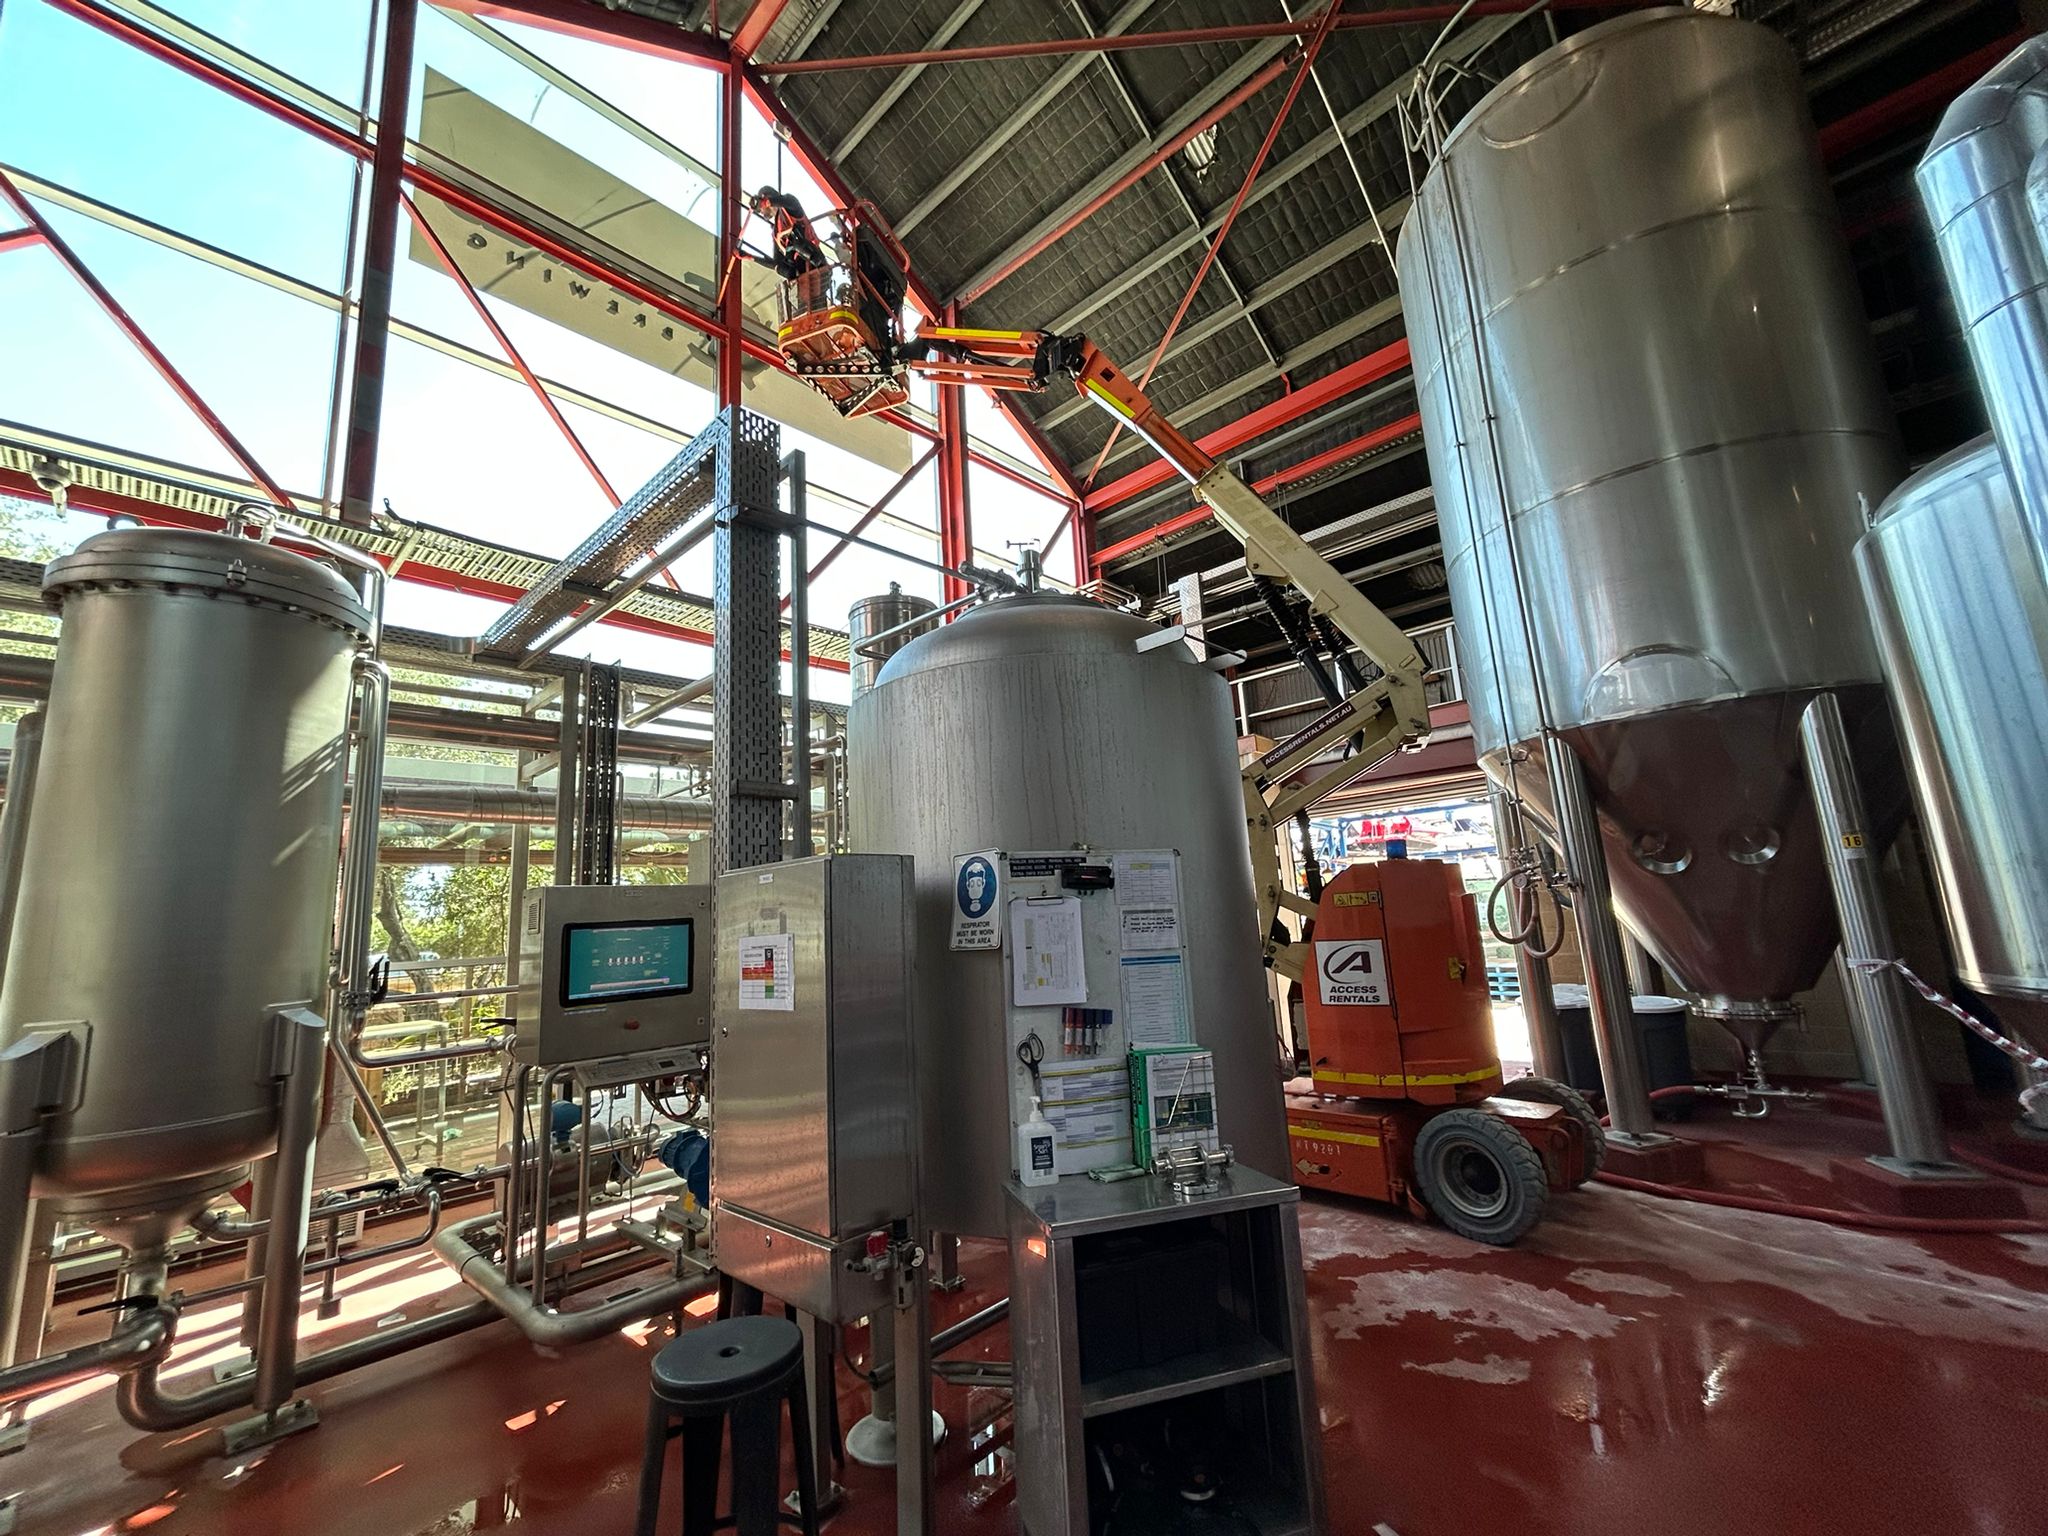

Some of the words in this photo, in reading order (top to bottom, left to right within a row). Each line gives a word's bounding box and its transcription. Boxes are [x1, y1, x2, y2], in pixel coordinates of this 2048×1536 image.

[1264, 705, 1352, 766] ACCESSRENTALS.NET.AU
[1844, 836, 1862, 847] 16
[961, 921, 990, 929] RESPIRATOR
[1330, 985, 1378, 994] ACCESS
[1329, 995, 1381, 1003] RENTALS
